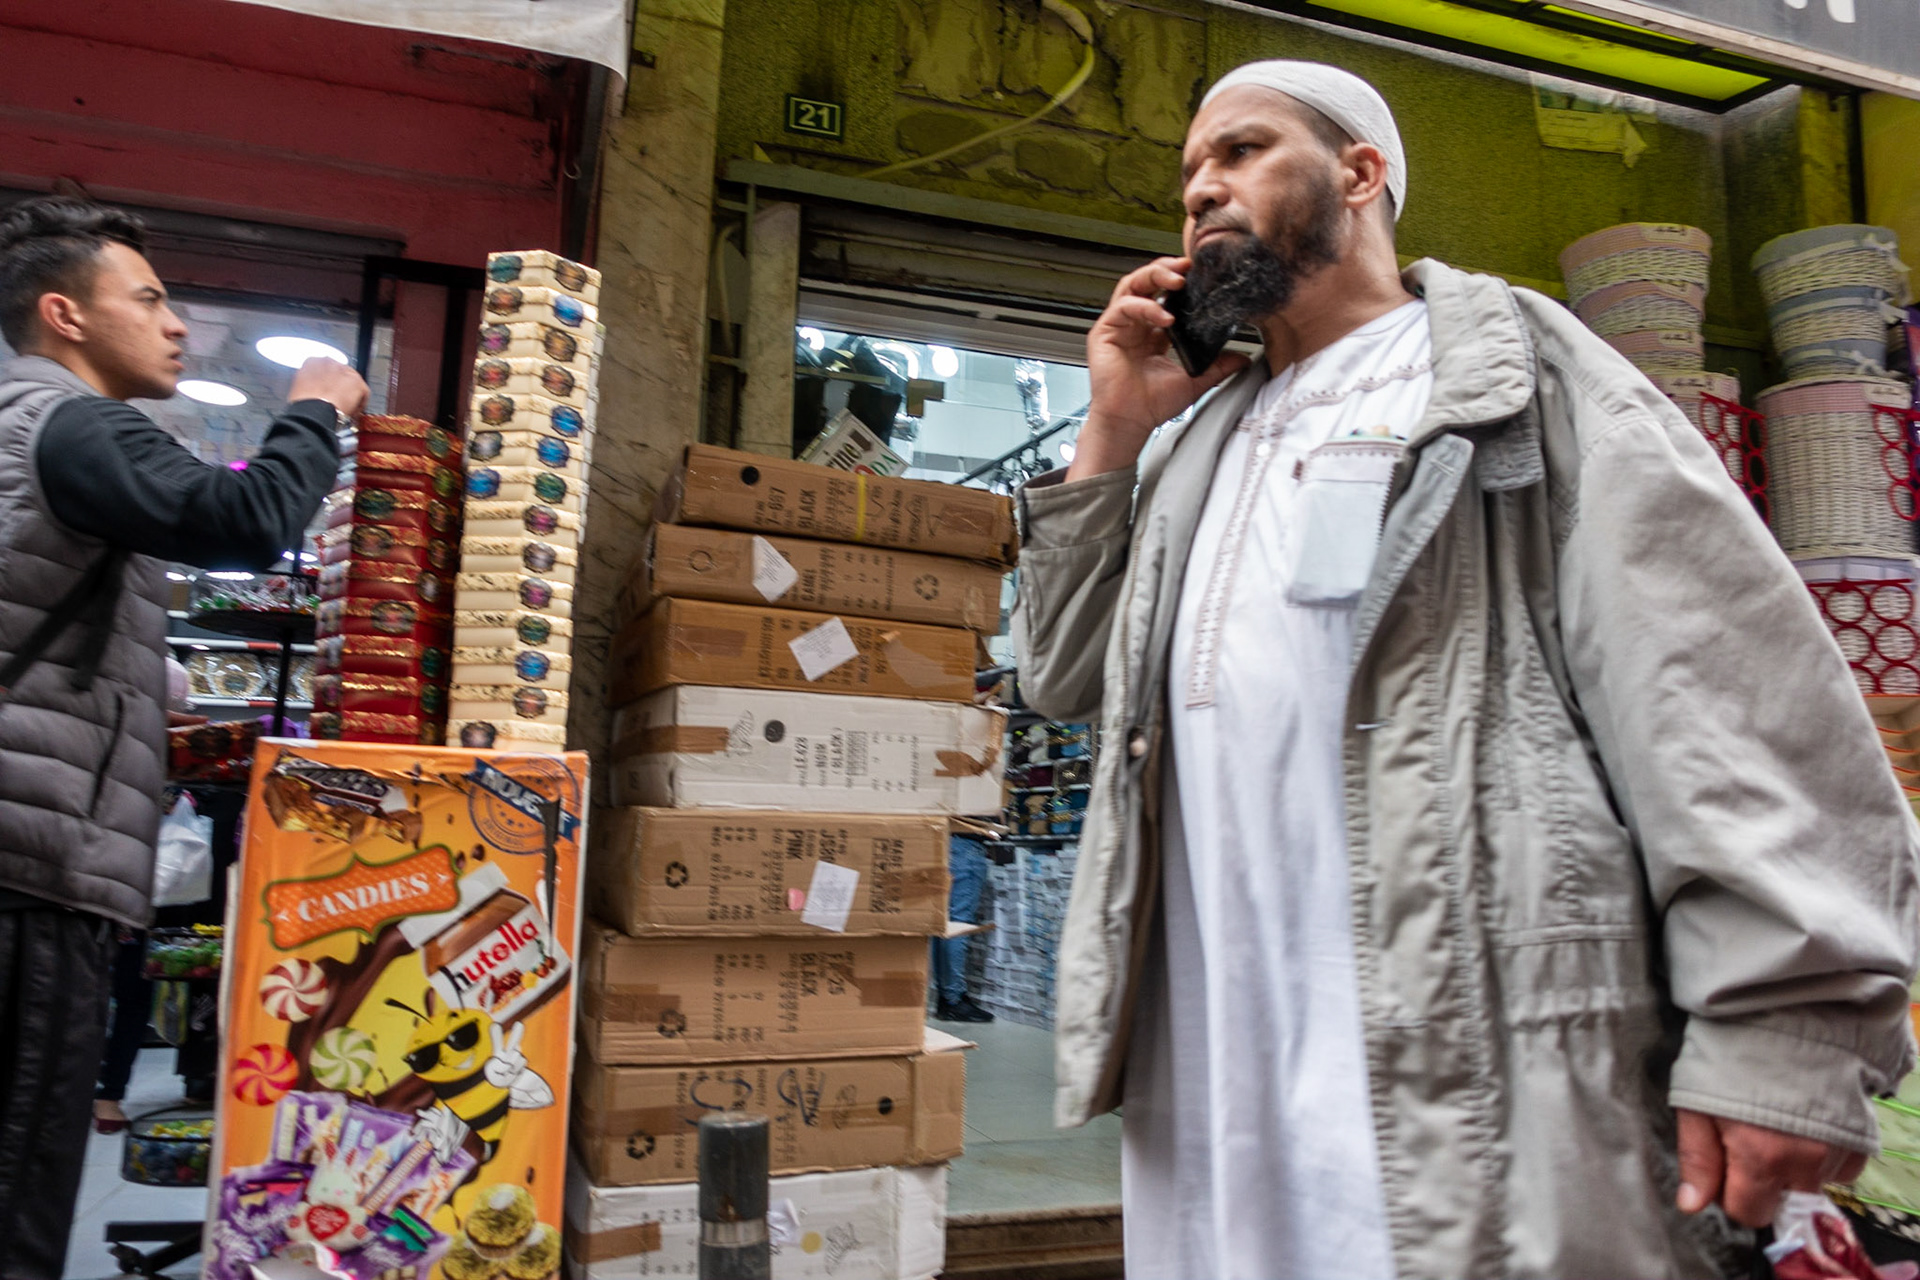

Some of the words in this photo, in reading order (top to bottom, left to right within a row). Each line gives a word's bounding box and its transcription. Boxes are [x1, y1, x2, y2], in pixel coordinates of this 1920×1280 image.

[798, 104, 831, 130] 21
[798, 489, 816, 529] BLACK
[786, 830, 803, 860] PINK
[890, 839, 904, 870] MADE
[298, 871, 431, 923] CANDIES
[800, 953, 818, 997] BLACK
